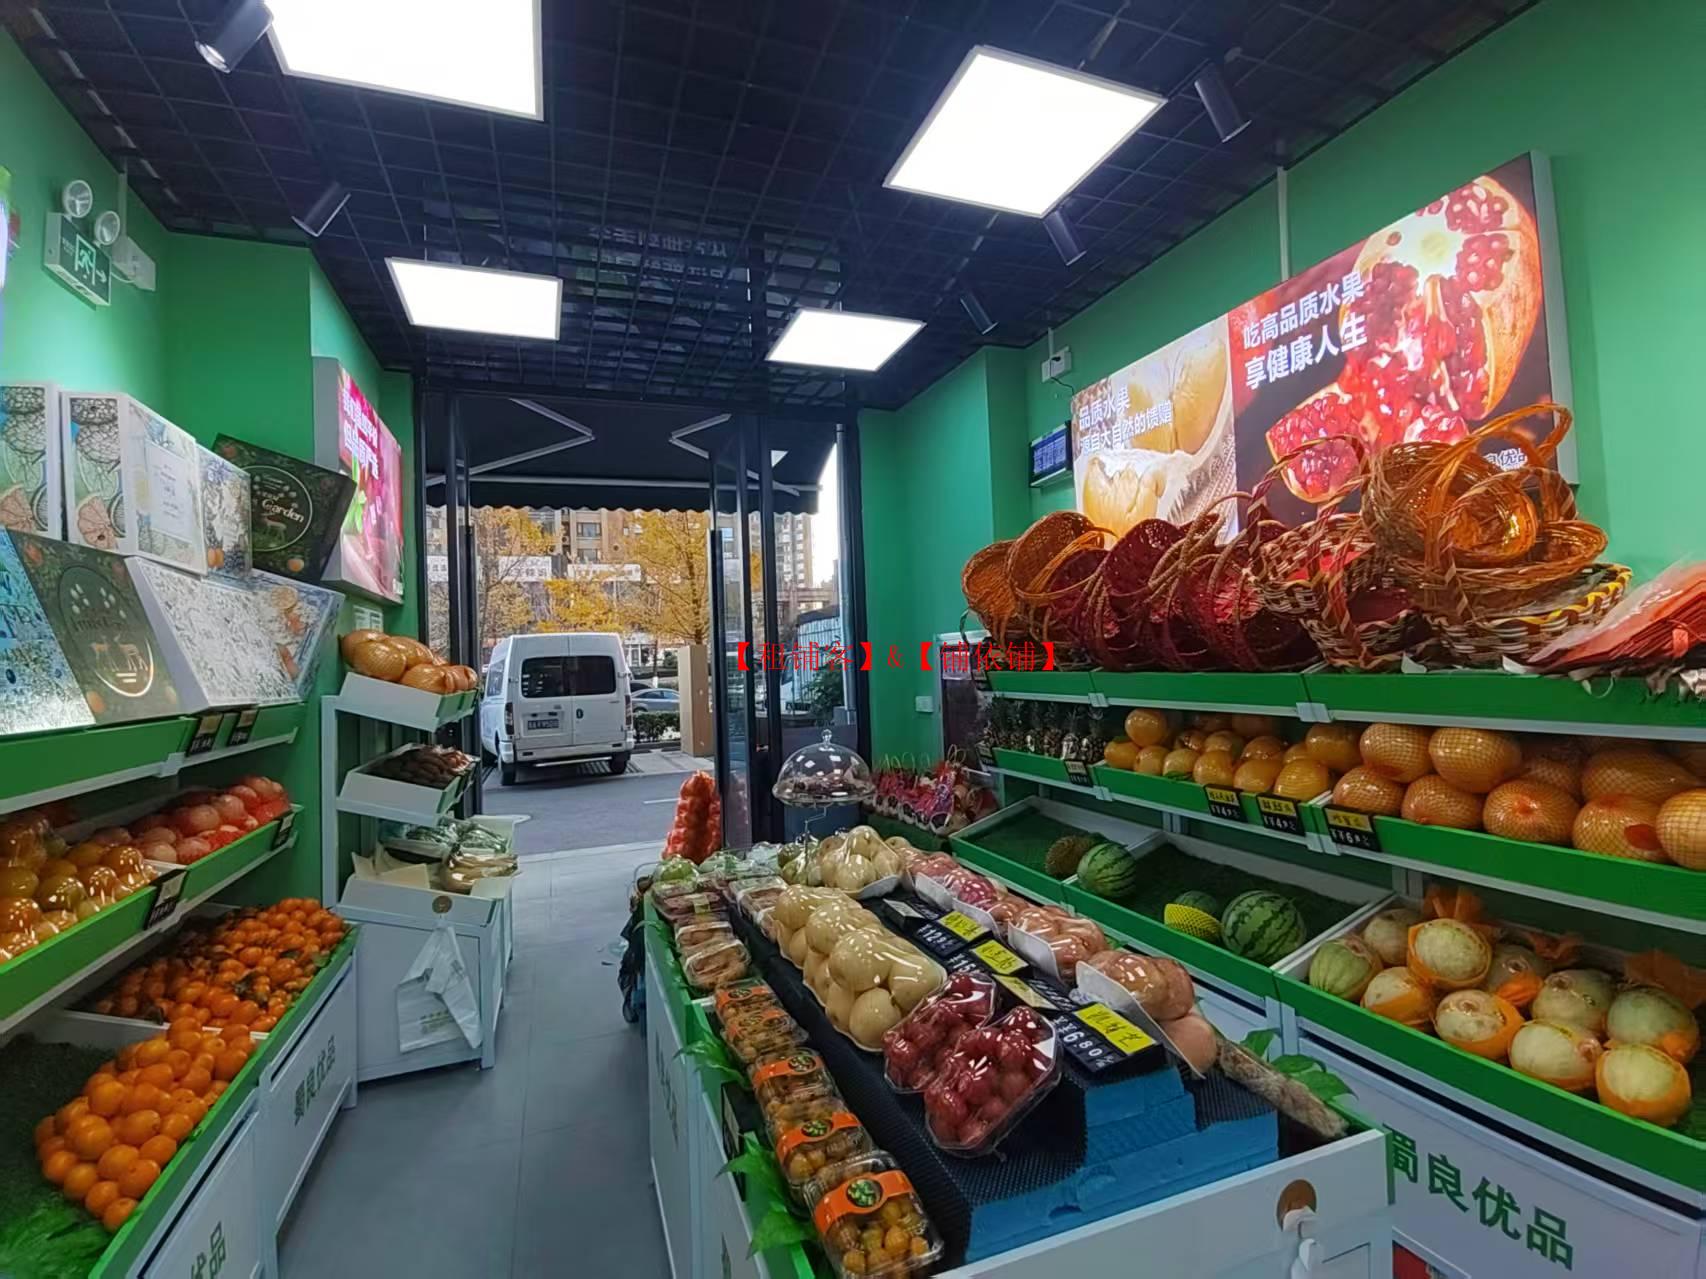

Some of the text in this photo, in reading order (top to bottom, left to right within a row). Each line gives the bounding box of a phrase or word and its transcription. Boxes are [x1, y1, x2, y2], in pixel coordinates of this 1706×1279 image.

[1243, 271, 1366, 349] 吃高品质水果
[1244, 312, 1368, 390] 享健康人生
[1079, 386, 1130, 431] 品质水果
[1080, 399, 1173, 454] 源自大自然的馈赠
[261, 498, 305, 523] Garden
